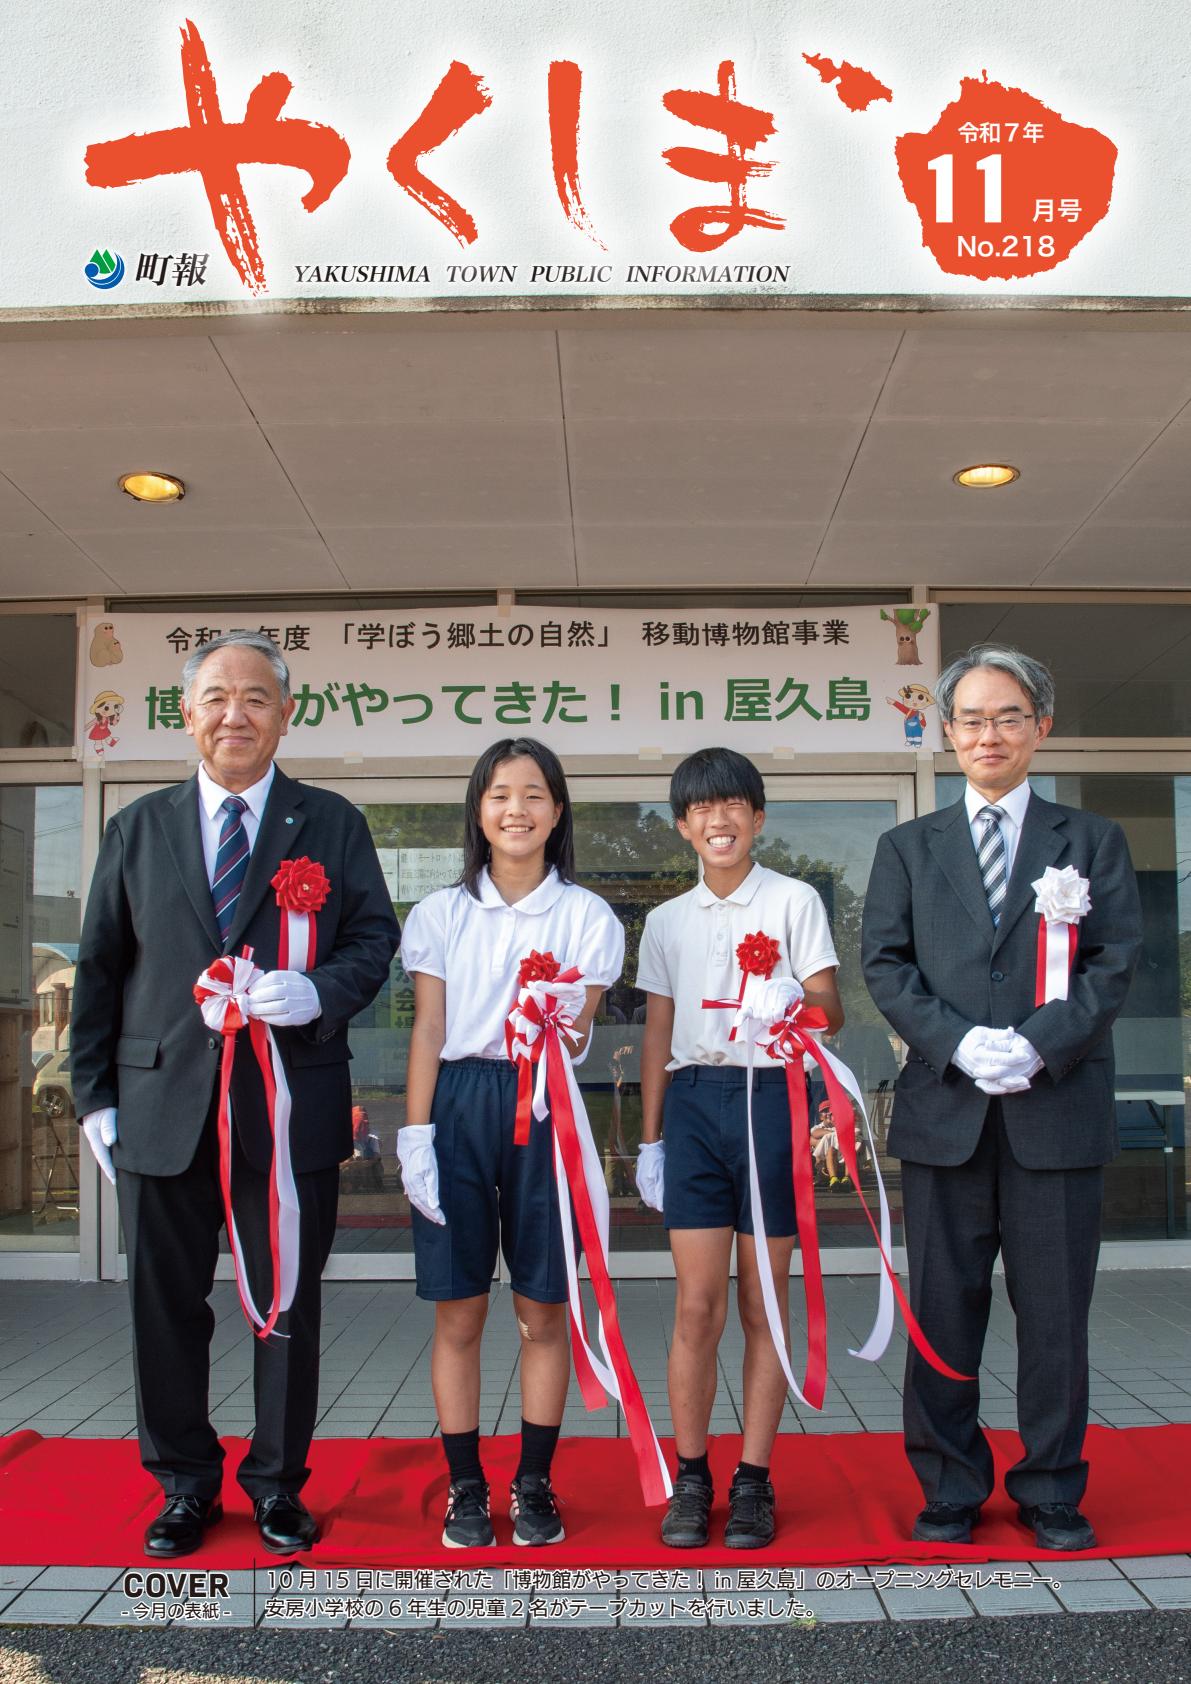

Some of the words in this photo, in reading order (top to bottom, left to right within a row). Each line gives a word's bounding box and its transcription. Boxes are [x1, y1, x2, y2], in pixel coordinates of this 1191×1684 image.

[343, 620, 609, 650] 「学ぼう郷土の自然」
[642, 619, 850, 647] 移動博物館事業
[660, 681, 704, 721] in
[724, 677, 871, 722] 屋久島
